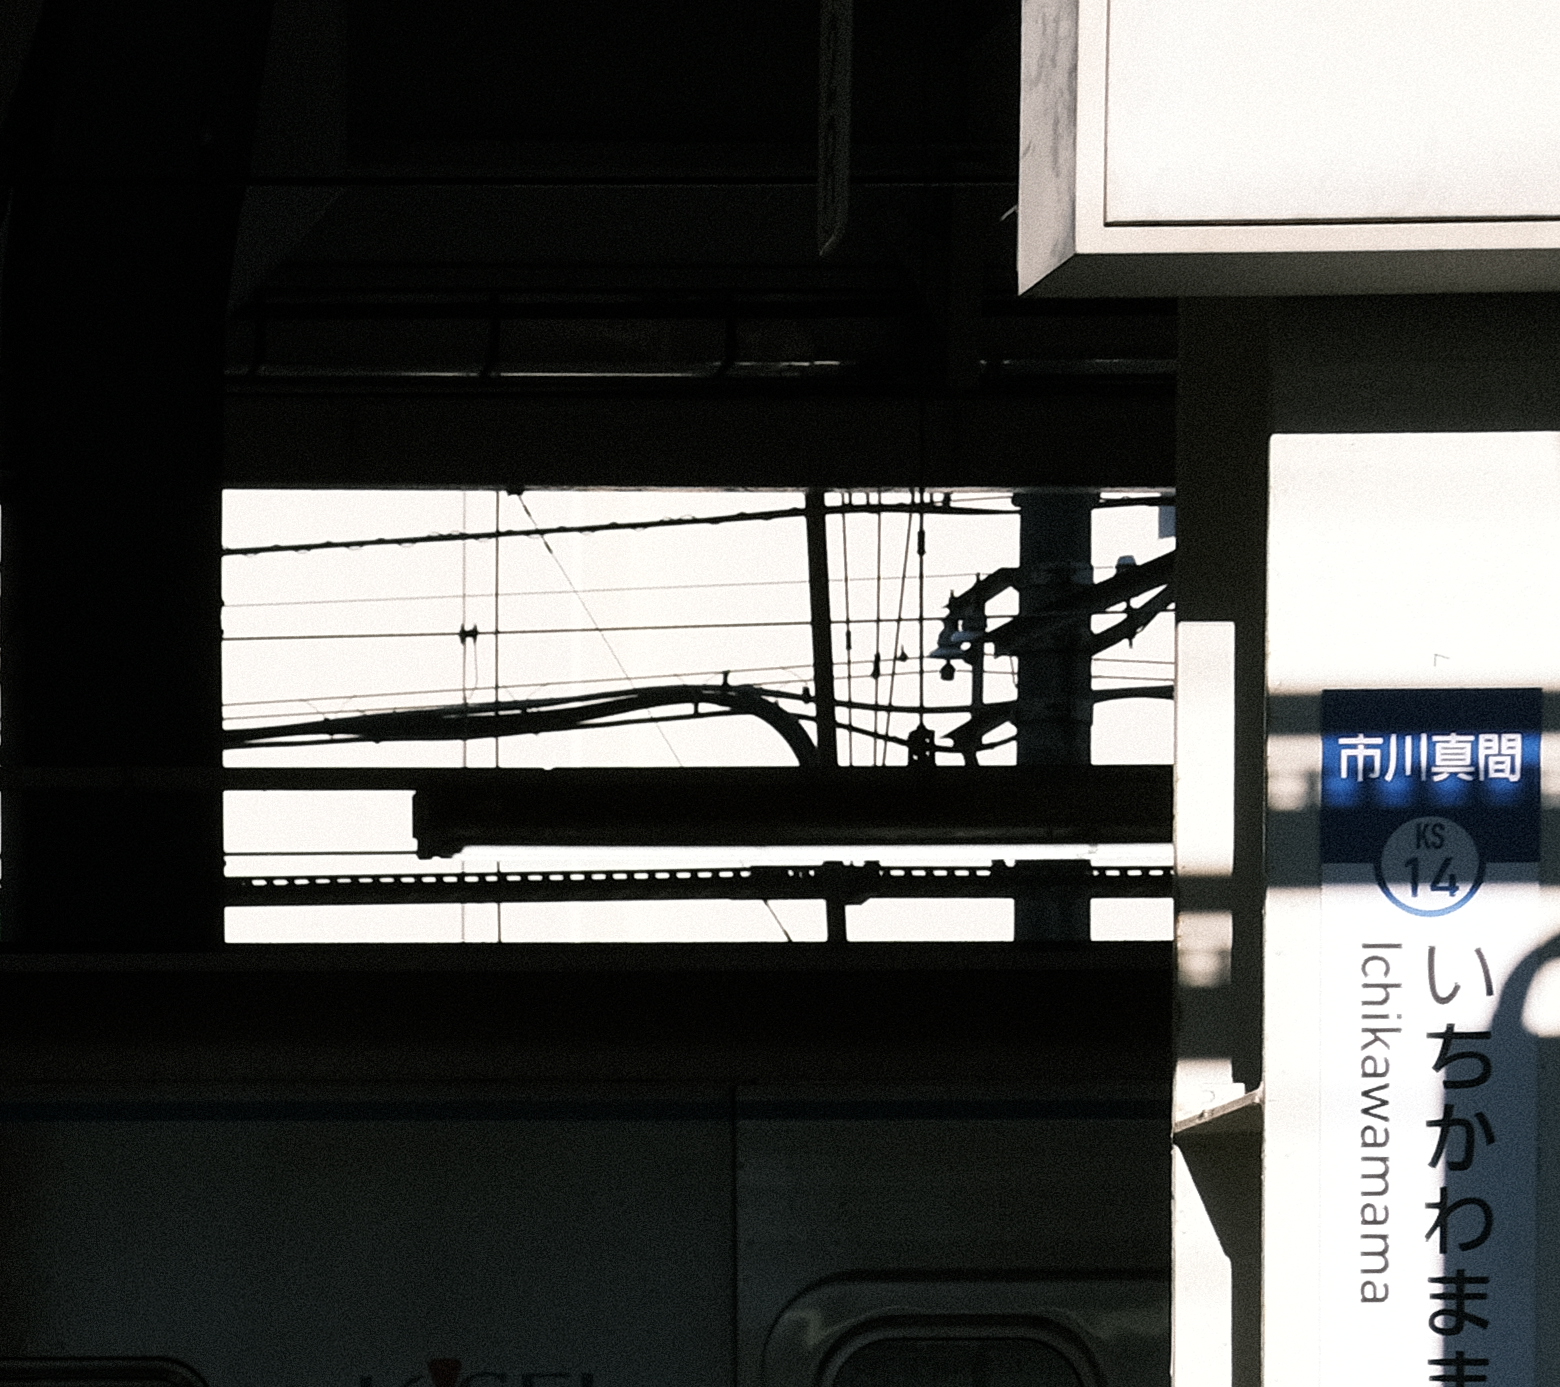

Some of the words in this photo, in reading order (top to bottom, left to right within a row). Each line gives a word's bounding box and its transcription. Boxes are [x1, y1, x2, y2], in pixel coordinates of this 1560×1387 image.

[1337, 731, 1523, 784] 市川真間
[1415, 822, 1446, 851] KS
[1403, 856, 1461, 899] 14
[1359, 942, 1403, 1305] Ichikawamama
